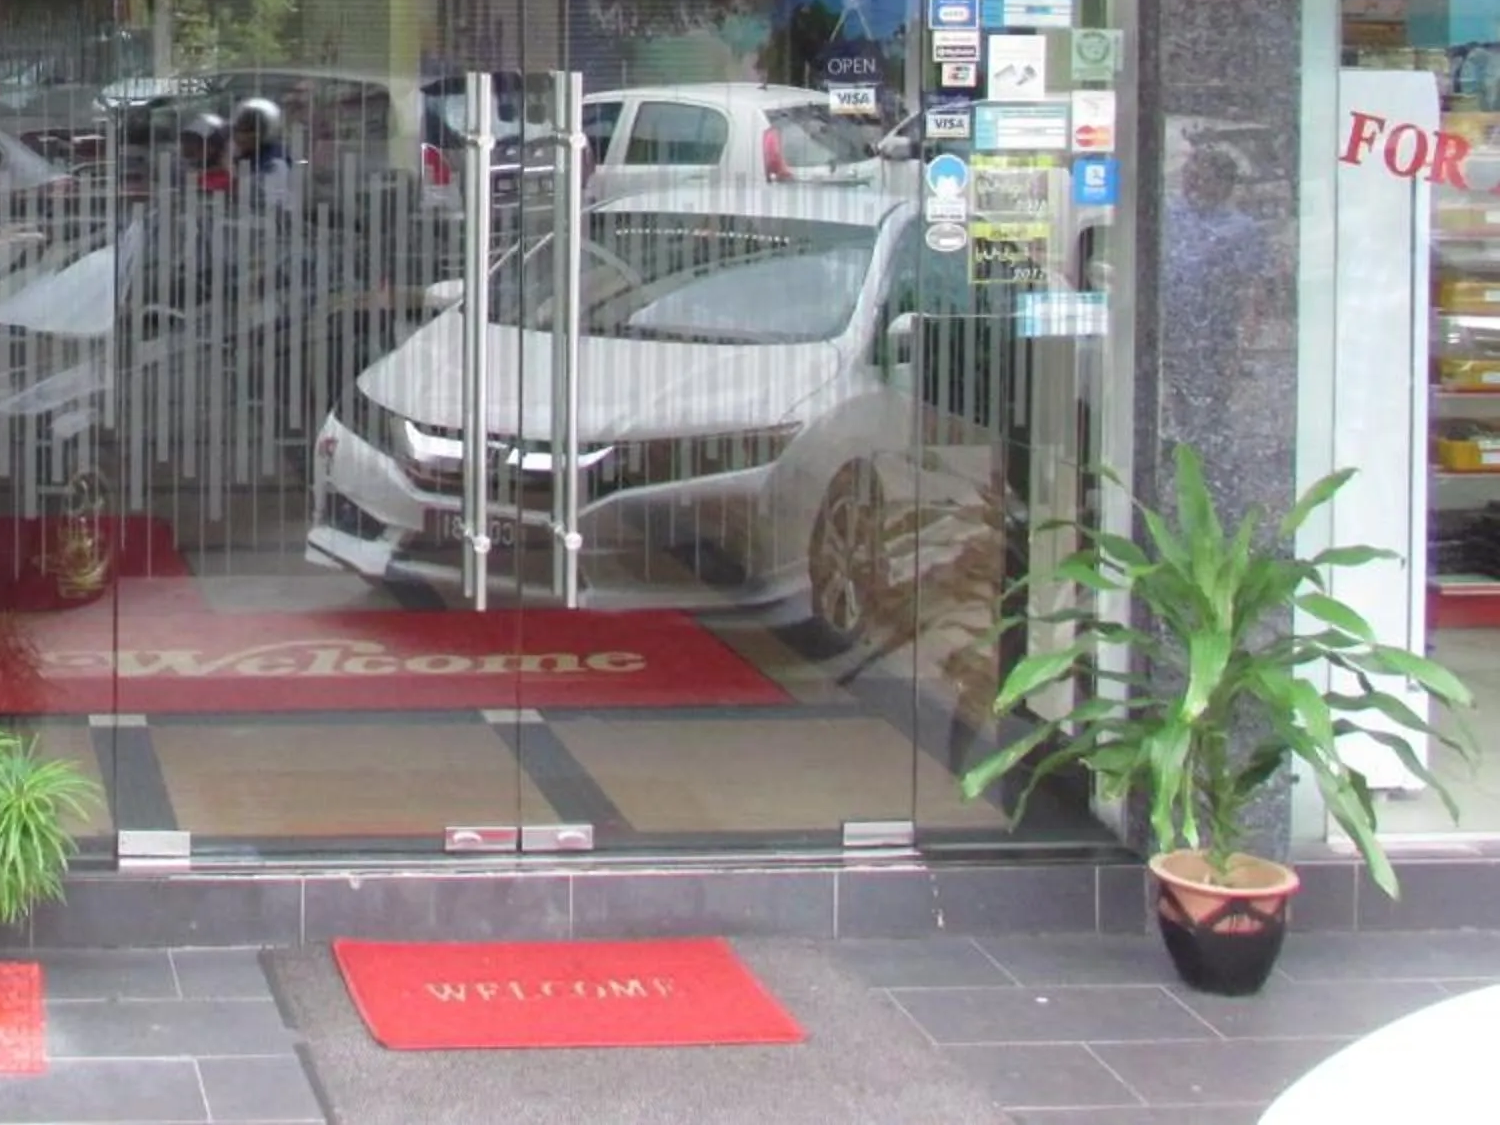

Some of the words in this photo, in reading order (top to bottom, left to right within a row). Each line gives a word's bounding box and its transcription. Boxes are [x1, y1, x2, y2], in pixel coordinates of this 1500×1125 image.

[827, 58, 877, 75] OPEN
[838, 91, 870, 105] VISA
[934, 117, 965, 130] VISA
[1338, 110, 1473, 190] FOR
[105, 639, 650, 676] Welcome
